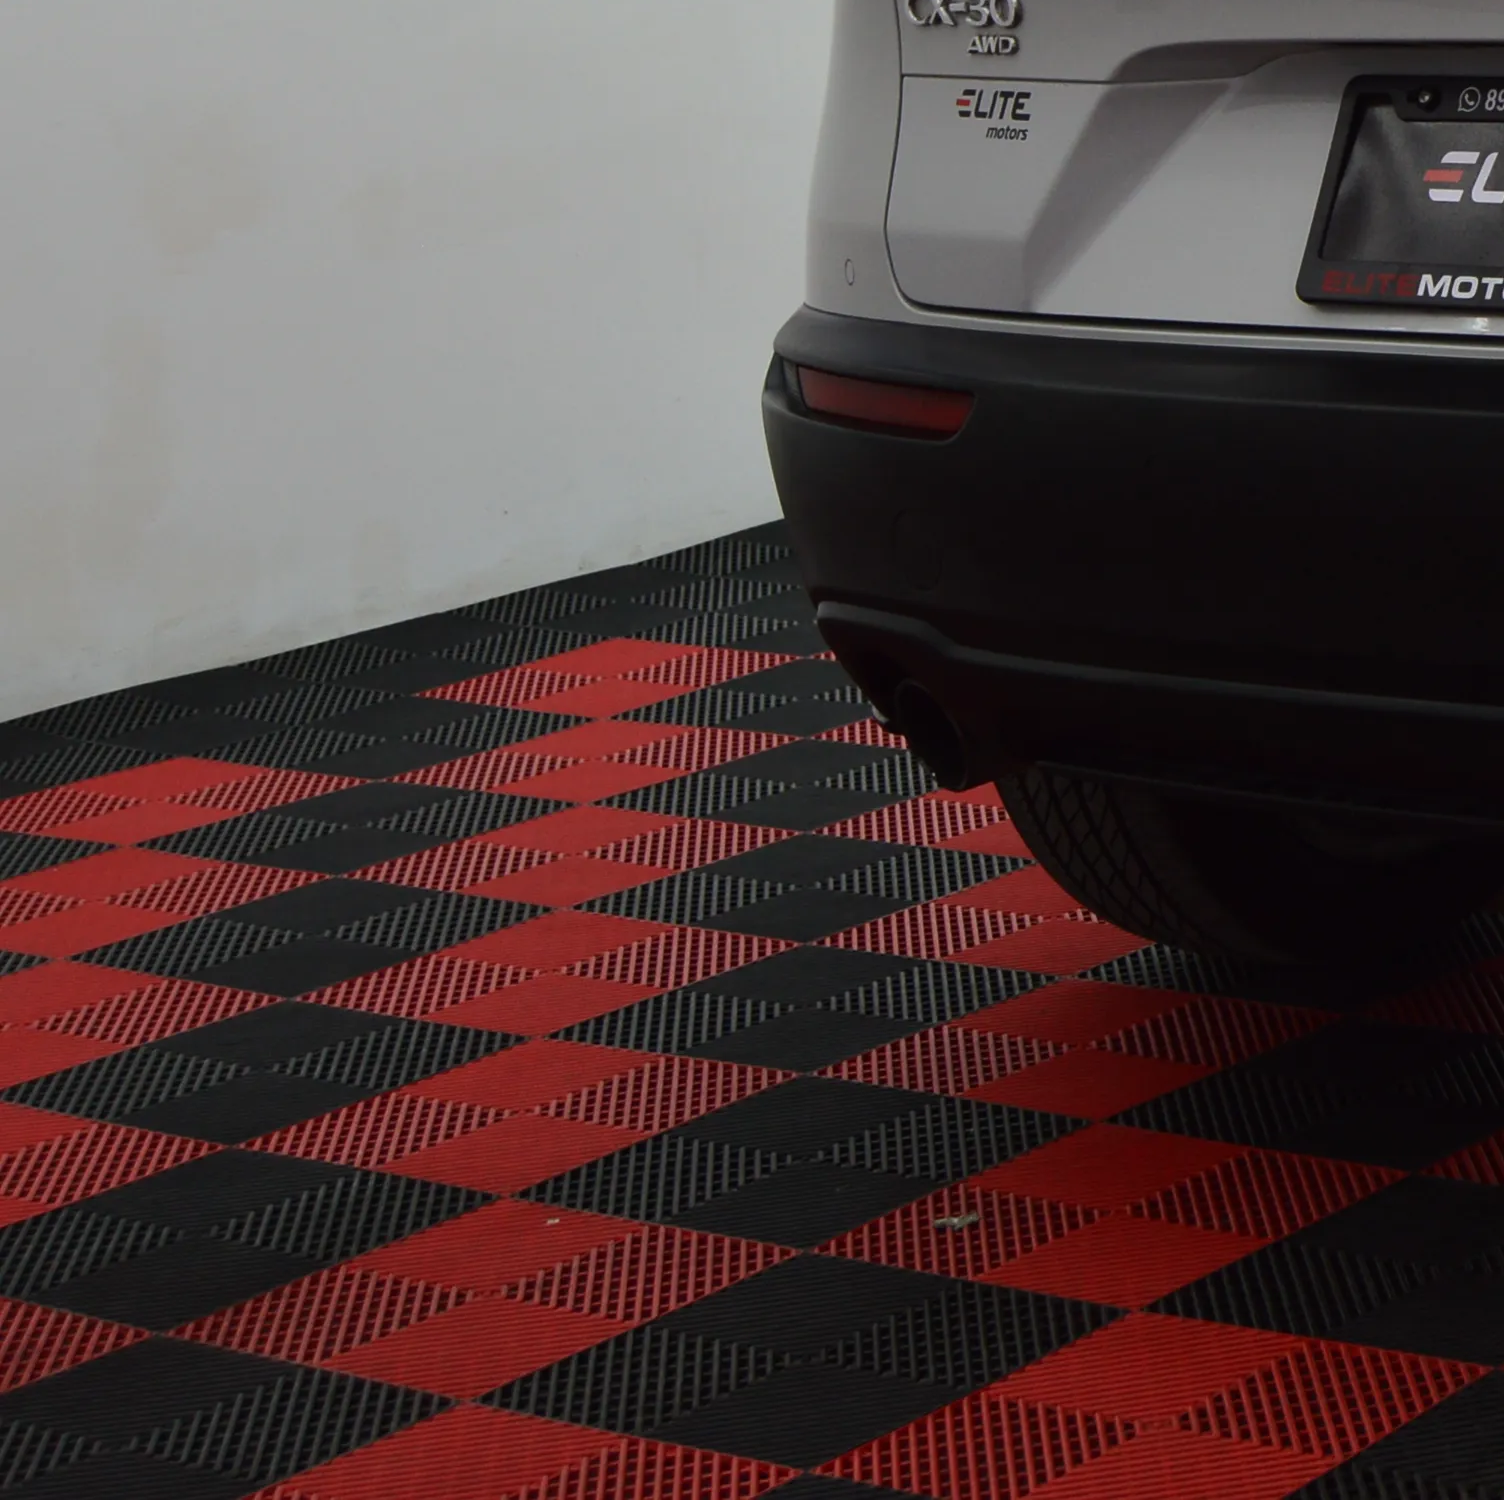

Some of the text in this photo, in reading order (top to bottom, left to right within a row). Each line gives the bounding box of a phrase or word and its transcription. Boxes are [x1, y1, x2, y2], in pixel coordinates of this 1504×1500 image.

[966, 35, 1018, 54] AWD
[956, 88, 1031, 121] ELITE
[986, 125, 1028, 141] motors
